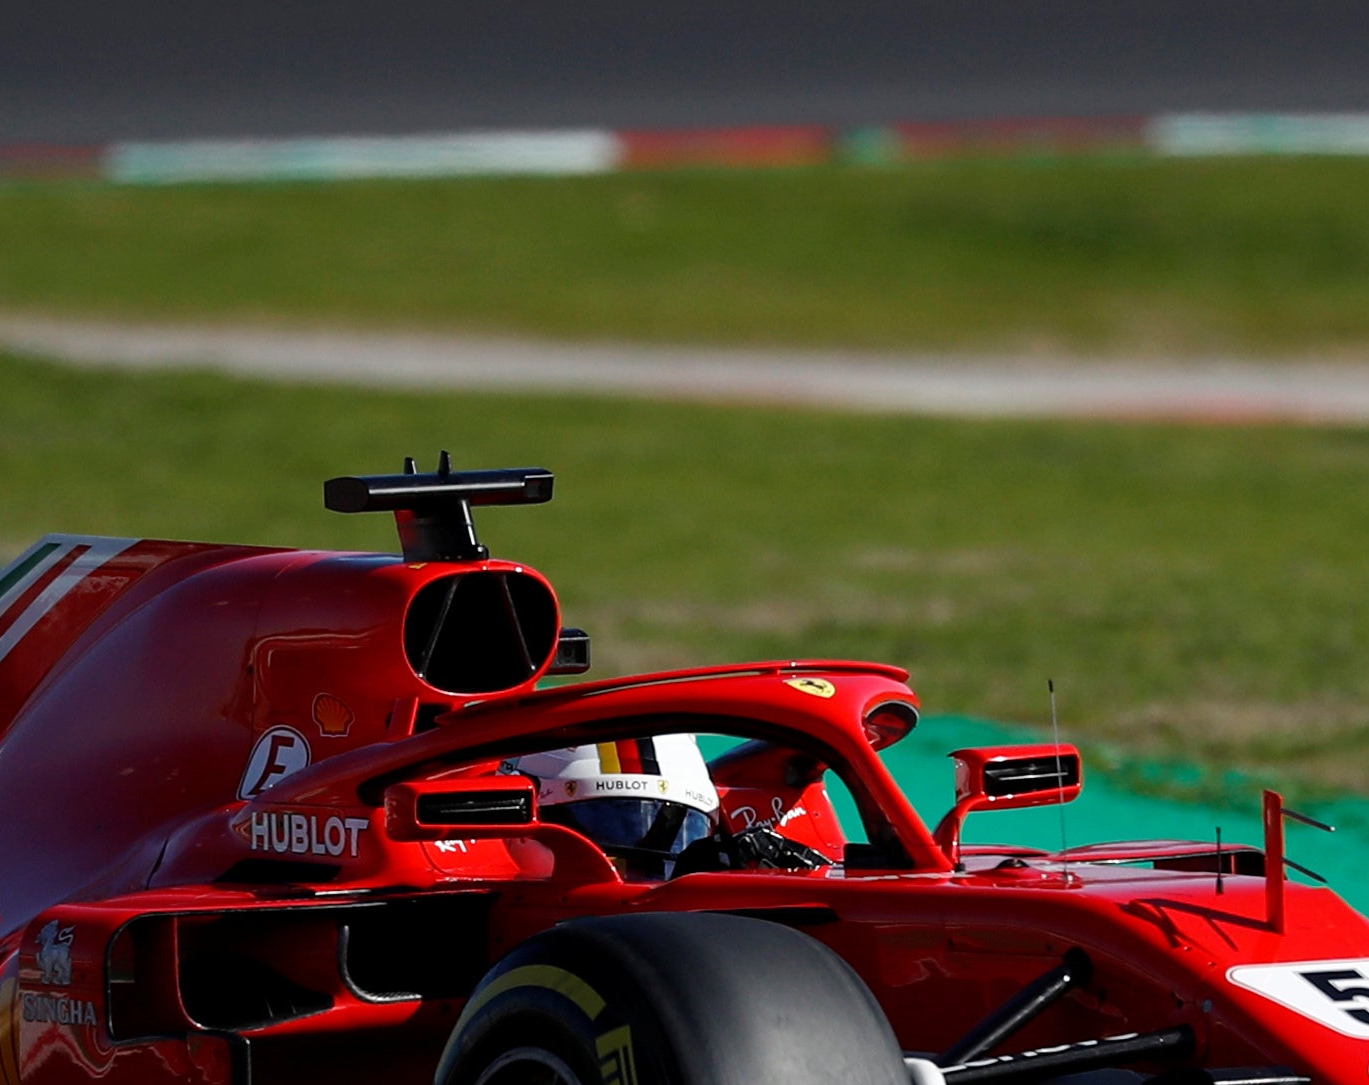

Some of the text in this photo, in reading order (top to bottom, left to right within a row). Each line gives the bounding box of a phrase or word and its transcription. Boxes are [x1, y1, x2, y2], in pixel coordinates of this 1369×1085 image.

[595, 780, 649, 791] HUBLOT
[251, 812, 369, 856] HUBLOT
[23, 994, 98, 1026] SINGHA
